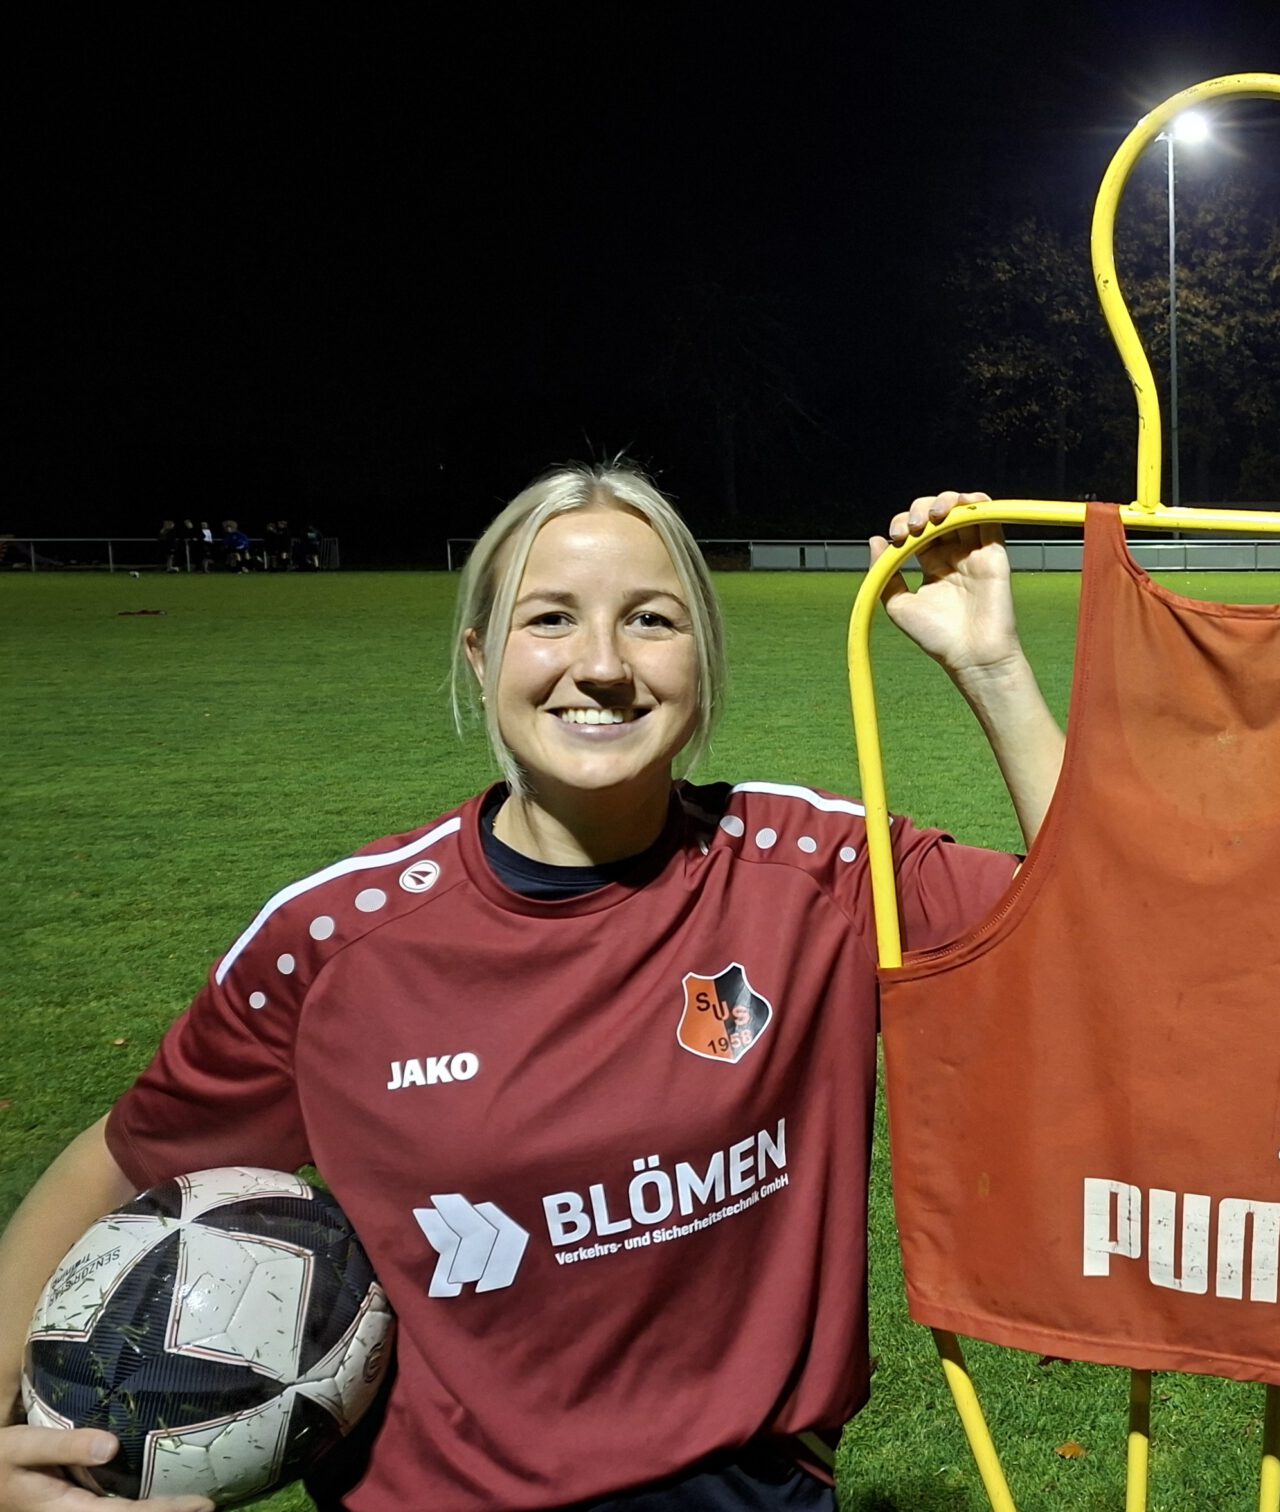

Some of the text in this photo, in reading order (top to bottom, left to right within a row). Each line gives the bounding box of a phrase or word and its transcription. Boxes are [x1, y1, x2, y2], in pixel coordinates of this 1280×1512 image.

[386, 1051, 480, 1091] JAKO
[707, 1029, 753, 1054] 1958
[542, 1117, 787, 1247] BLÖMEN
[555, 1172, 789, 1266] Verkehrs- und Sicherheitstechnik GmbH
